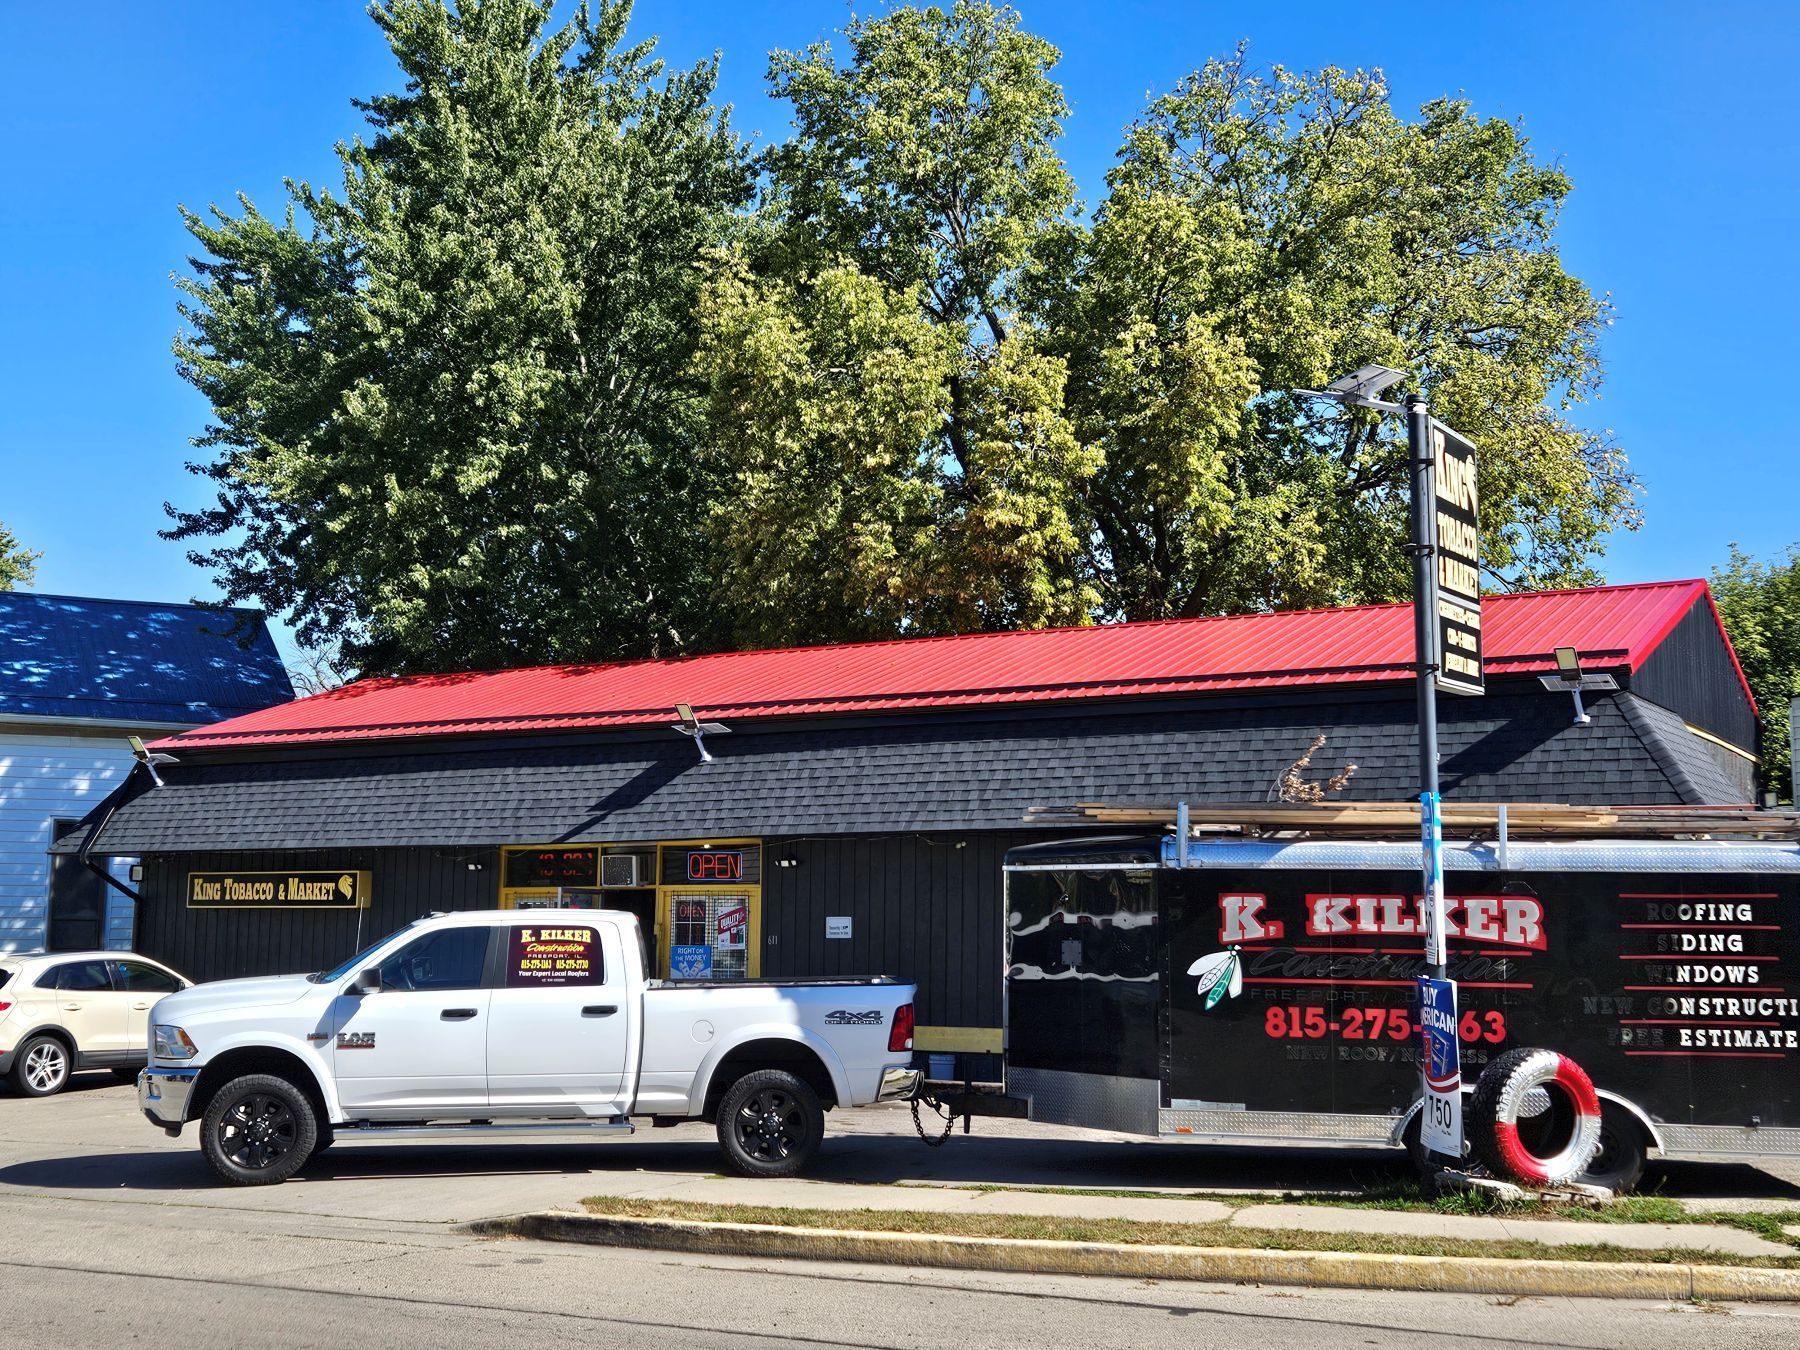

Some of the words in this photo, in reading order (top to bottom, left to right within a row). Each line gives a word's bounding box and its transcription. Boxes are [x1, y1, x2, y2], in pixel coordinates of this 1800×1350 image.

[1437, 510, 1477, 562] TOBACCO
[690, 854, 741, 878] OPEN
[193, 878, 221, 900] KING
[224, 878, 274, 900] TOBACCO
[278, 883, 285, 900] &
[287, 878, 335, 900] MARKET
[679, 904, 705, 918] OPEN
[1219, 894, 1284, 944] K.
[1647, 903, 1752, 922] ROOFING
[521, 930, 536, 943] K.
[540, 930, 591, 943] KILKER
[767, 935, 778, 945] 611
[1657, 934, 1743, 952] SIDING
[527, 943, 585, 953] Construction
[677, 947, 696, 955] RIGHT
[1645, 965, 1759, 983] WINDOWS
[1583, 996, 1633, 1015] NEW
[1264, 1006, 1506, 1044] 815-275-63
[1607, 1028, 1664, 1046] FREE
[1286, 1045, 1329, 1062] NEW
[1458, 1047, 1489, 1065] ESS
